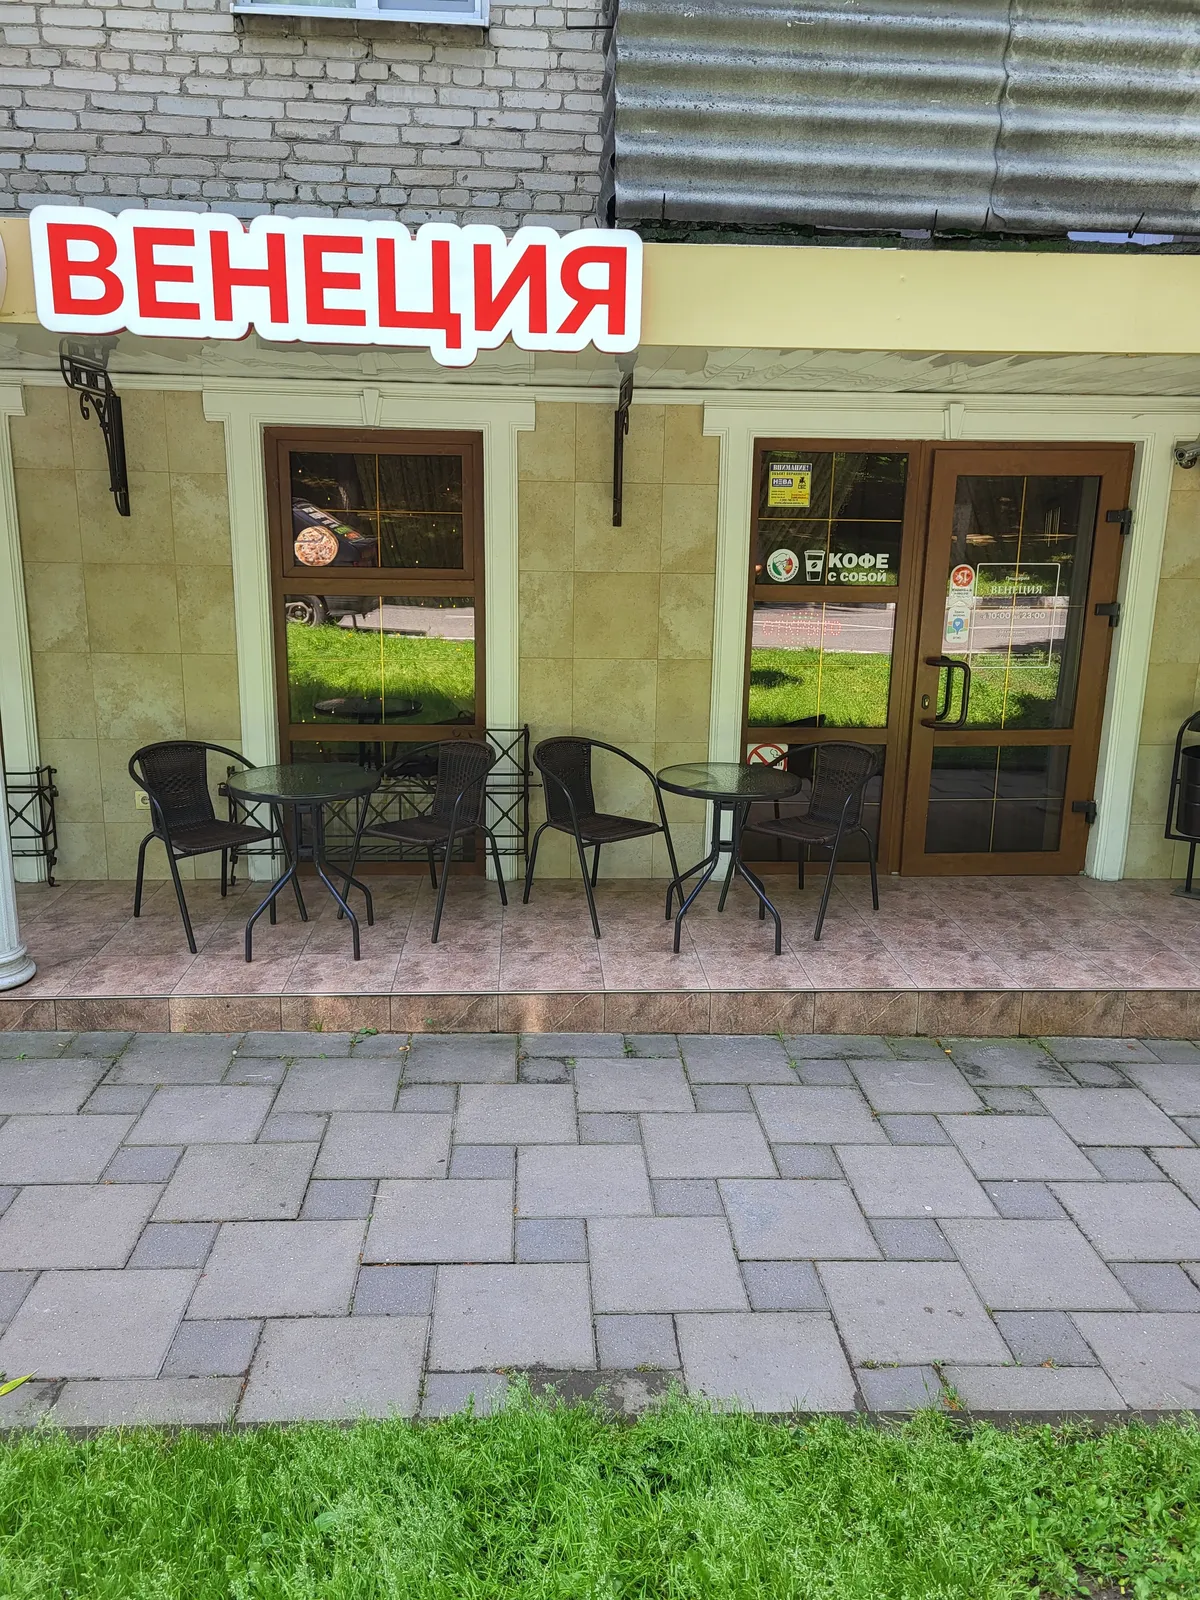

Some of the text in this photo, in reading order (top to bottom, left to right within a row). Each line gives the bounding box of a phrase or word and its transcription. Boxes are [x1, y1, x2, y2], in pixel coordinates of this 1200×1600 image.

[47, 222, 628, 349] ВЕНЕЦИЯ
[828, 553, 890, 568] КОФЕ
[828, 570, 887, 581] С СОБОЙ
[991, 586, 1043, 595] ВЕНЕЦИЯ
